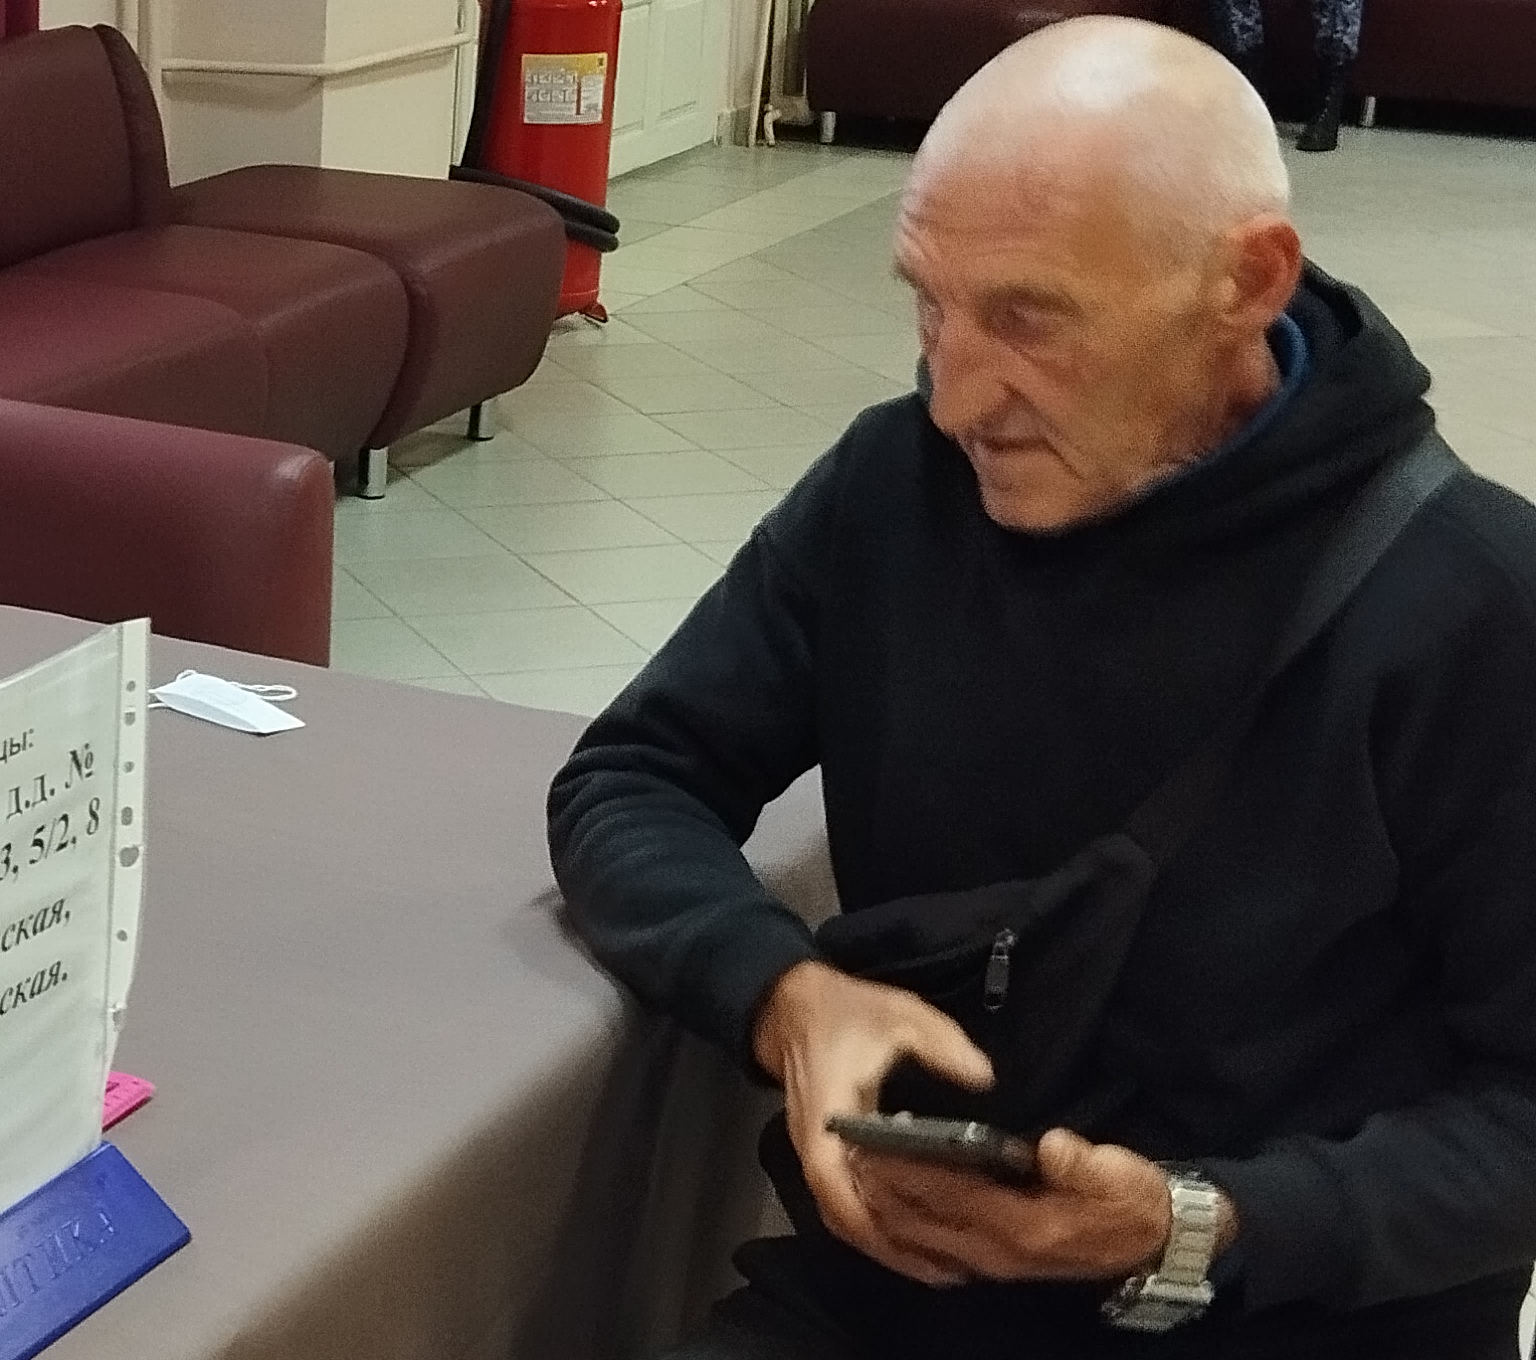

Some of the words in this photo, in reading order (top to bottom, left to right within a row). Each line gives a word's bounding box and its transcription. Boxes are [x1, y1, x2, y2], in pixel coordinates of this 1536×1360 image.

[65, 743, 94, 790] №
[29, 813, 77, 866] 5/2,
[86, 797, 100, 837] 8
